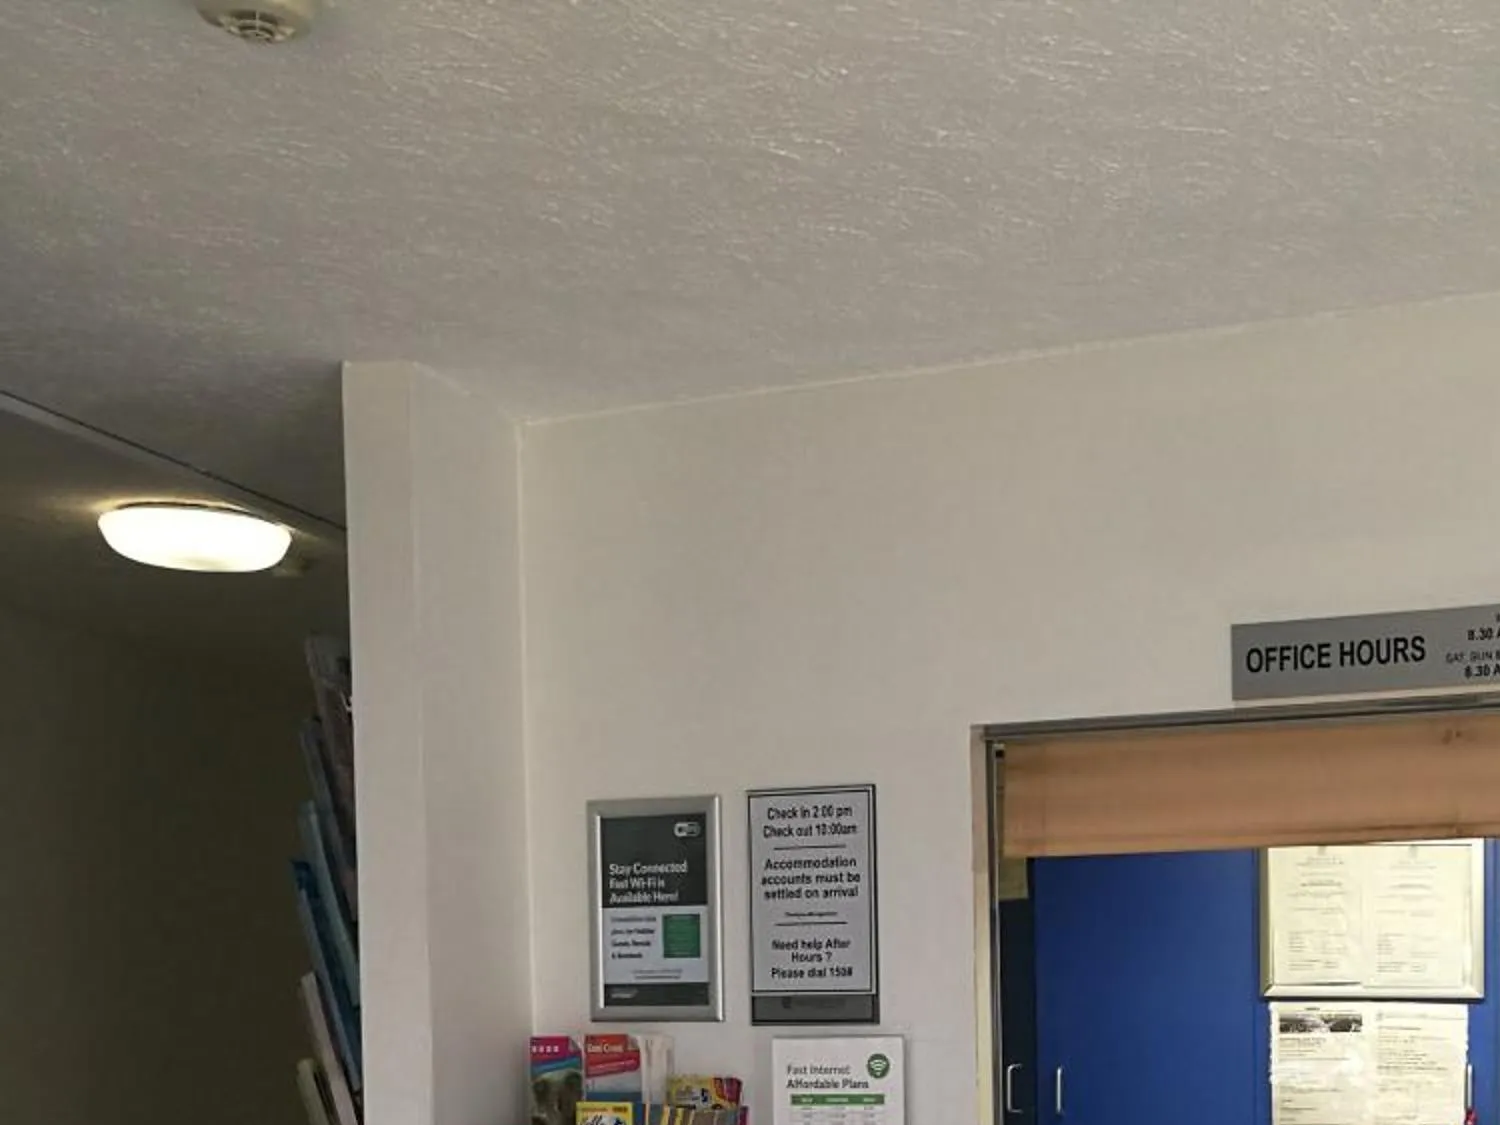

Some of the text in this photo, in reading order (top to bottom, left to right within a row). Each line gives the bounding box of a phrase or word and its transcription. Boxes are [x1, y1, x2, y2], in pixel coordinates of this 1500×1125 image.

[1467, 627, 1493, 641] 8.30
[1246, 635, 1427, 673] OFFICE HOURS
[1470, 650, 1493, 662] SUN
[767, 807, 798, 820] Check
[801, 806, 810, 819] in
[836, 806, 853, 819] pm
[763, 824, 794, 838] Check
[796, 825, 812, 837] out
[609, 860, 688, 876] Stay Connected
[764, 856, 857, 870] Accommodation
[609, 878, 629, 889] Fast
[761, 871, 860, 886] accounts must be
[609, 891, 652, 904] Available
[764, 885, 858, 899] settled on arrival
[771, 938, 851, 951] Need help After
[791, 952, 823, 963] Hours
[771, 967, 805, 979] Please
[808, 967, 826, 977] dial
[787, 1064, 851, 1076] Fast Internet
[786, 1078, 869, 1089] Affordable Plans
